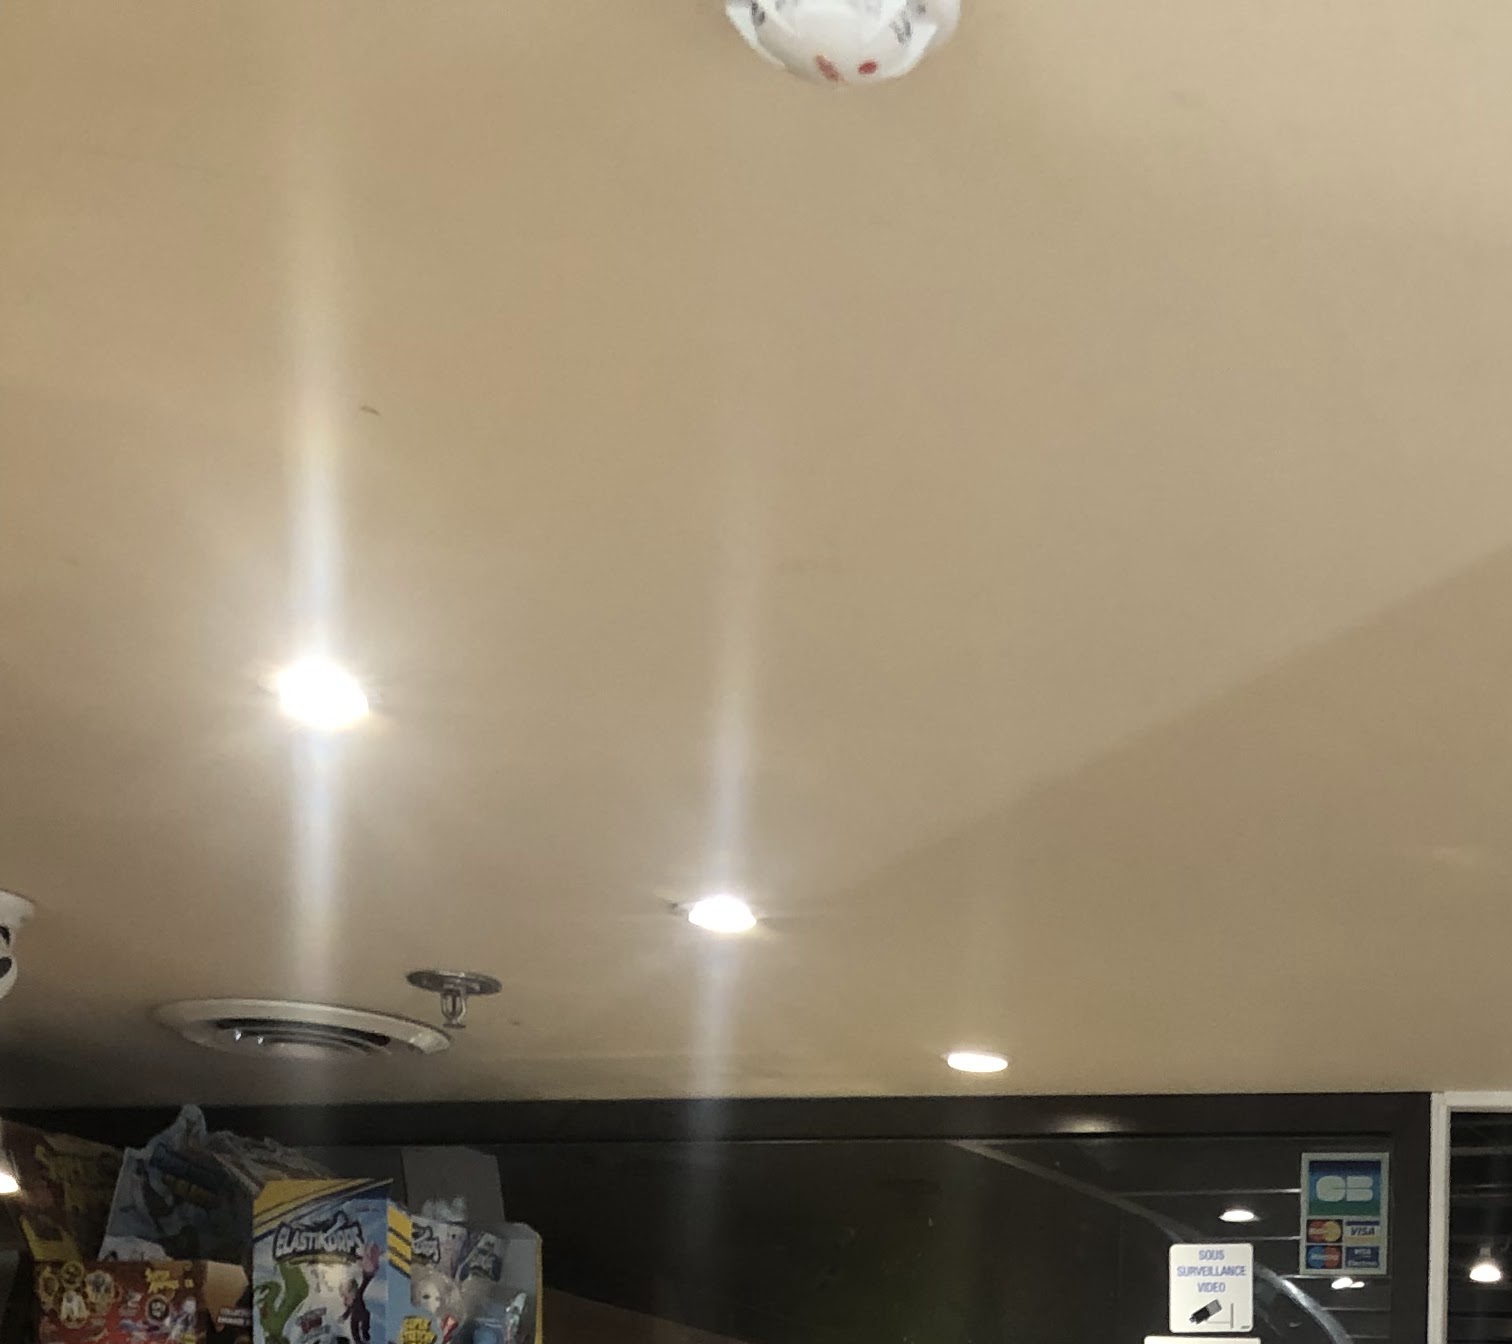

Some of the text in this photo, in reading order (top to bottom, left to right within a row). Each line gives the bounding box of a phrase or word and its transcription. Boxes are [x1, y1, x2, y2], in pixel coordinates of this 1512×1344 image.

[1316, 1175, 1373, 1201] CB
[1350, 1228, 1375, 1236] VISA
[1199, 1250, 1224, 1260] SOUS
[1177, 1265, 1246, 1277] SURVEILLANCE
[1198, 1282, 1225, 1292] VIDEO
